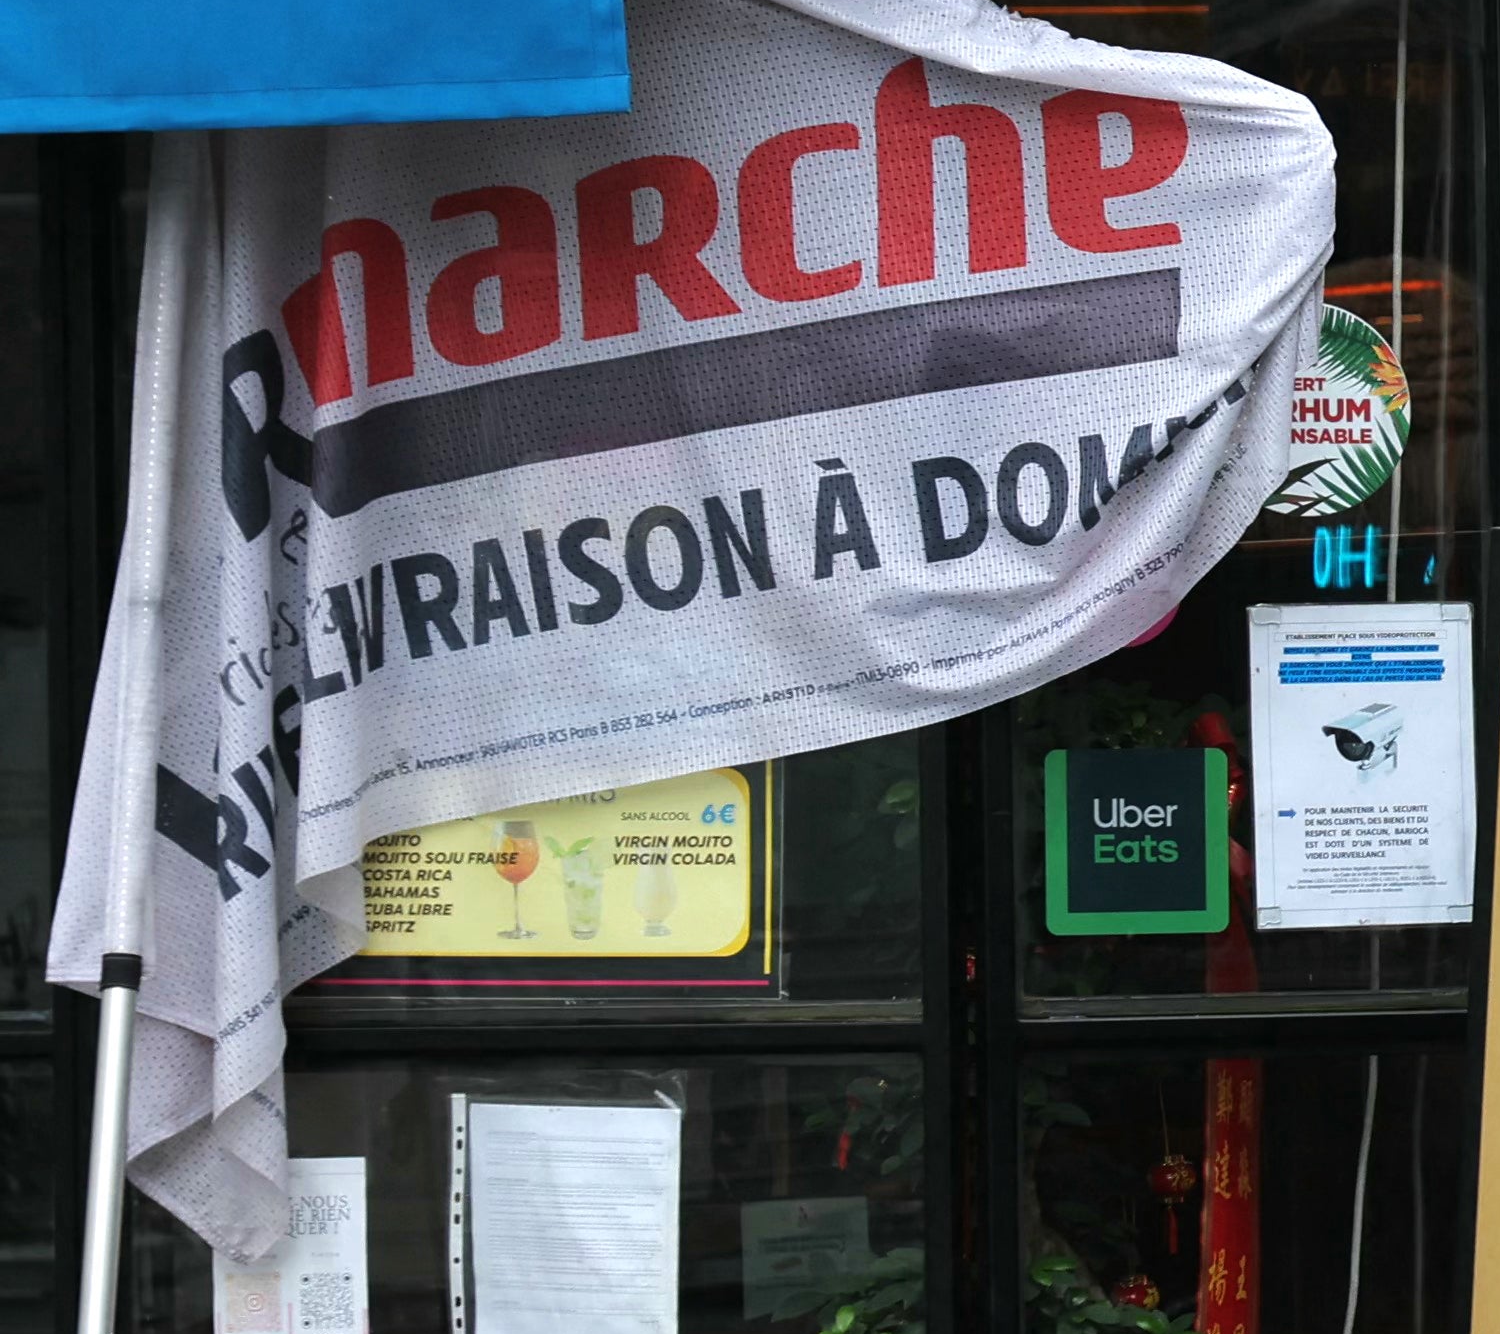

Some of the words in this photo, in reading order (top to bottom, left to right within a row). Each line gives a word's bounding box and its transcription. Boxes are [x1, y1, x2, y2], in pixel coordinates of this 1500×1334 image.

[1294, 378, 1326, 391] ERT
[1291, 429, 1372, 444] NSABLE
[812, 459, 881, 581] À
[620, 812, 647, 821] SANS
[649, 811, 691, 821] ALCOOL
[701, 804, 735, 824] 6€
[1093, 798, 1179, 829] Uber
[1331, 806, 1374, 814] MAINTENIR
[1393, 805, 1428, 813] SECURITE
[614, 836, 669, 848] VIRGIN
[672, 835, 733, 849] MOJITO
[1305, 841, 1318, 849] EST
[1325, 840, 1345, 848] DOTE
[1093, 834, 1180, 865] Eats
[1306, 852, 1329, 860] VIDEO
[1331, 851, 1385, 859] SURVEILLANCE
[364, 853, 422, 864] MOJITO
[425, 852, 464, 864] SOJU
[468, 852, 519, 864] FRAISE
[613, 853, 668, 865] VIRGIN
[671, 853, 736, 865] COLADA
[363, 870, 415, 881] COSTA
[418, 869, 453, 881] RICA
[364, 887, 440, 899] BAHAMAS
[408, 904, 452, 915] LIBRE
[285, 1222, 328, 1238] QUER
